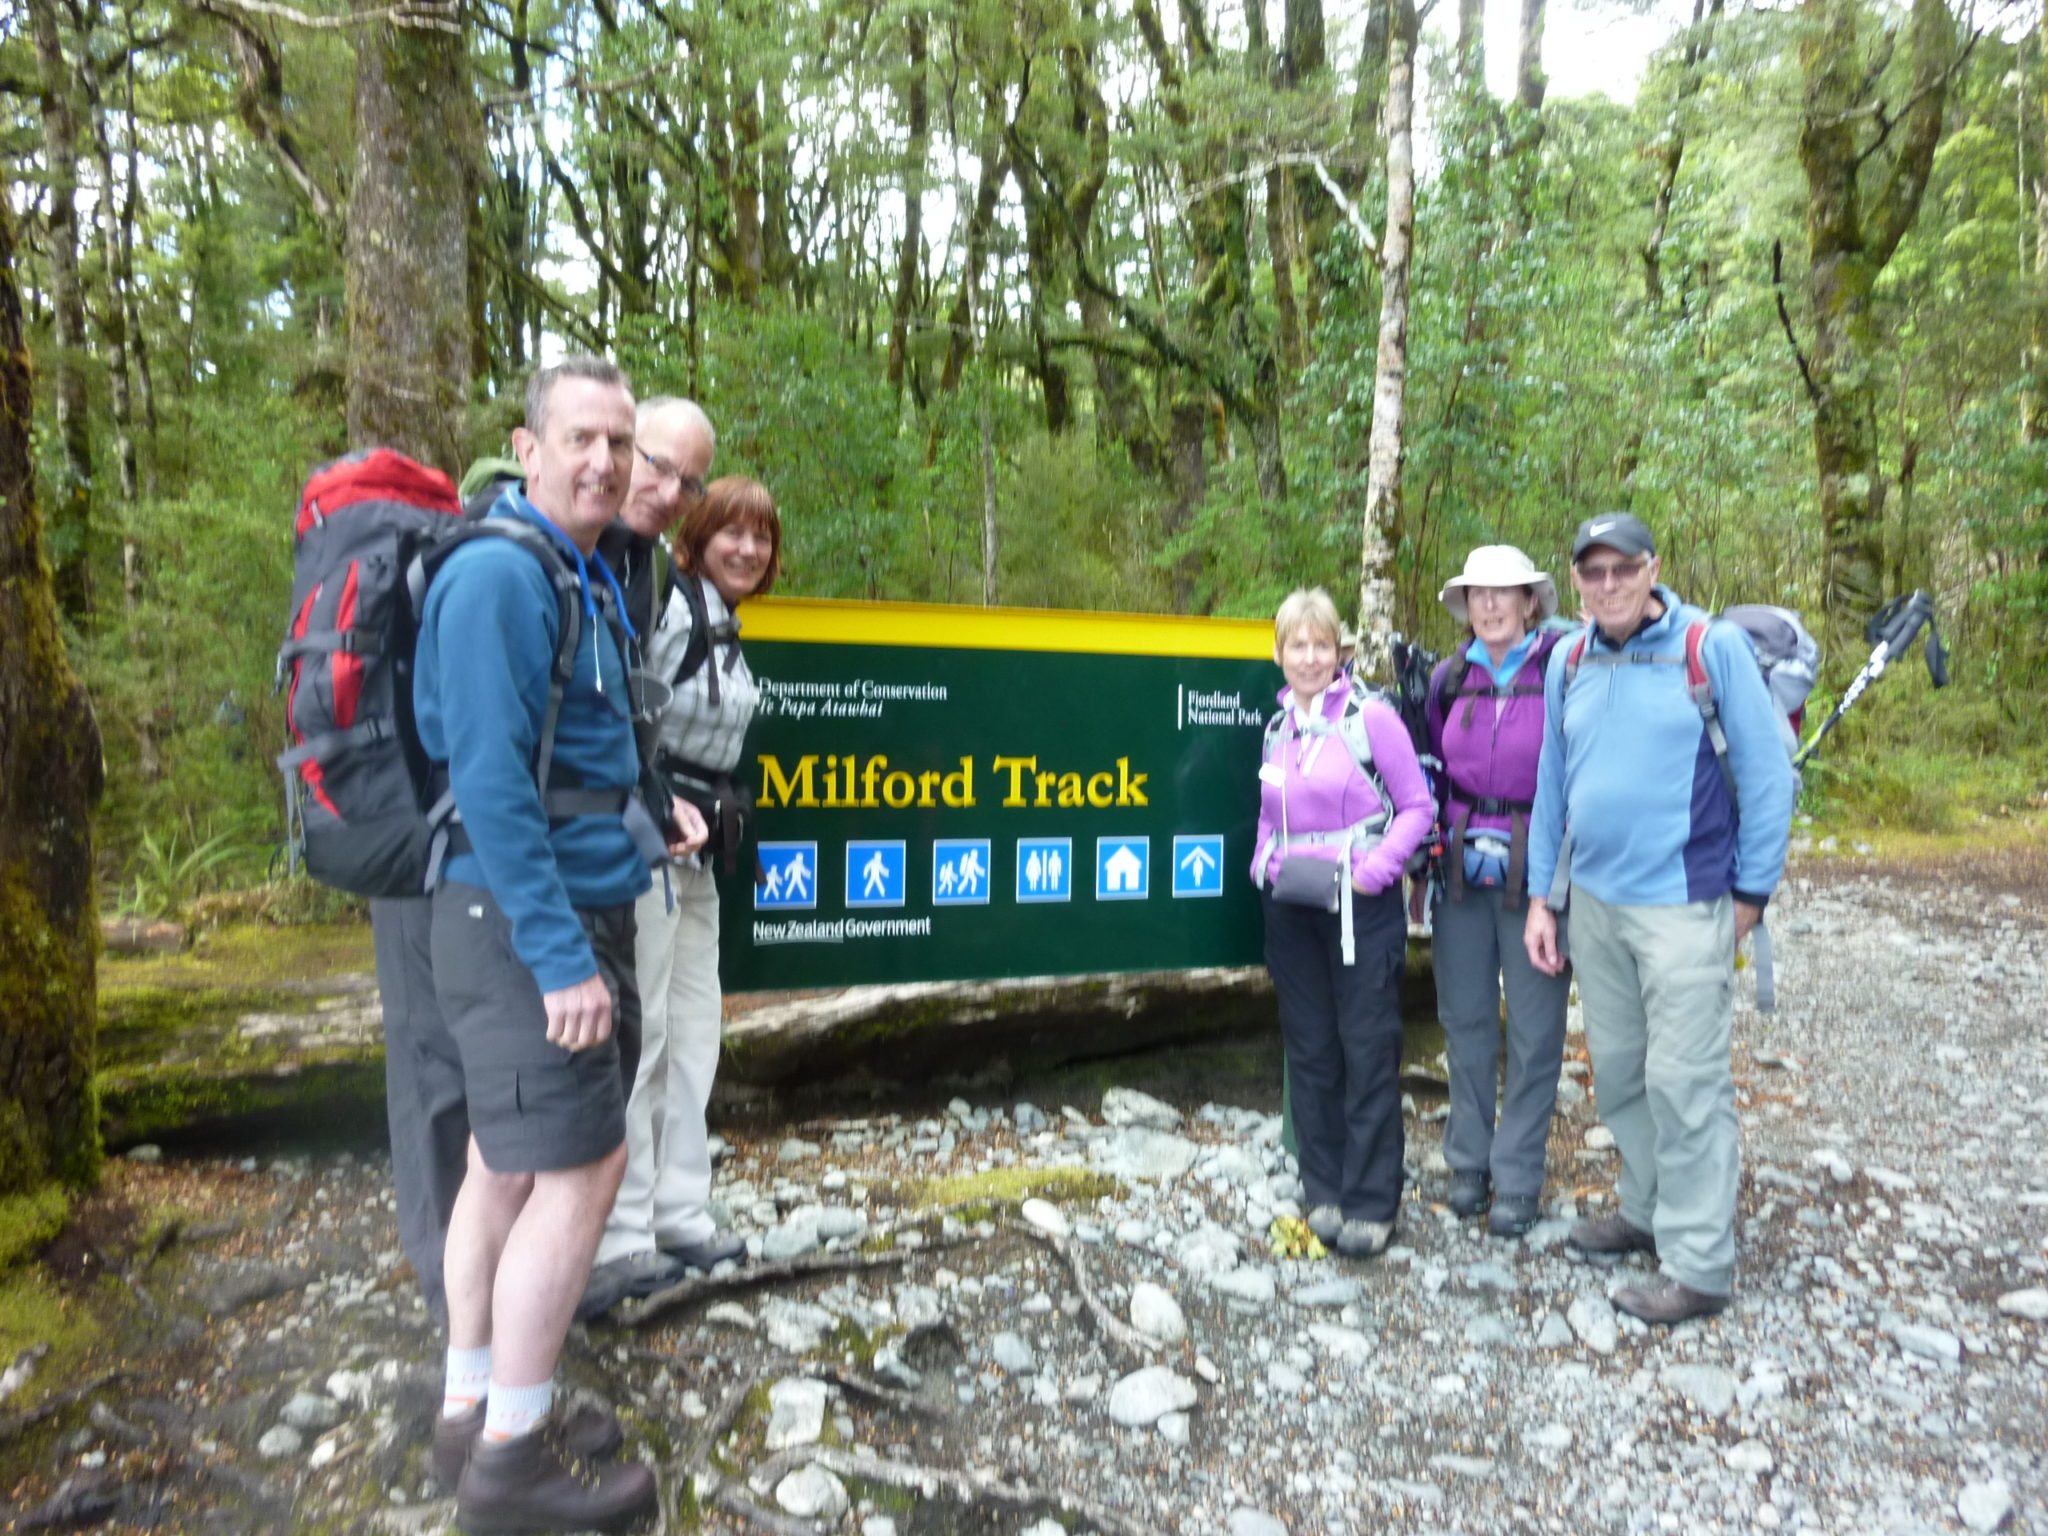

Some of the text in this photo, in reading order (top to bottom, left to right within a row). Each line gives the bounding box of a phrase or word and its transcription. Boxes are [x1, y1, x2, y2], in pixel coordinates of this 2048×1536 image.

[759, 677, 947, 701] Department of Conservation
[1188, 690, 1240, 709] Fiordland
[760, 697, 883, 720] Te Papa Atawhai
[1188, 707, 1262, 726] National Park
[756, 754, 976, 808] Milford
[993, 755, 1149, 807] Track
[753, 916, 931, 942] New Zealand Government
